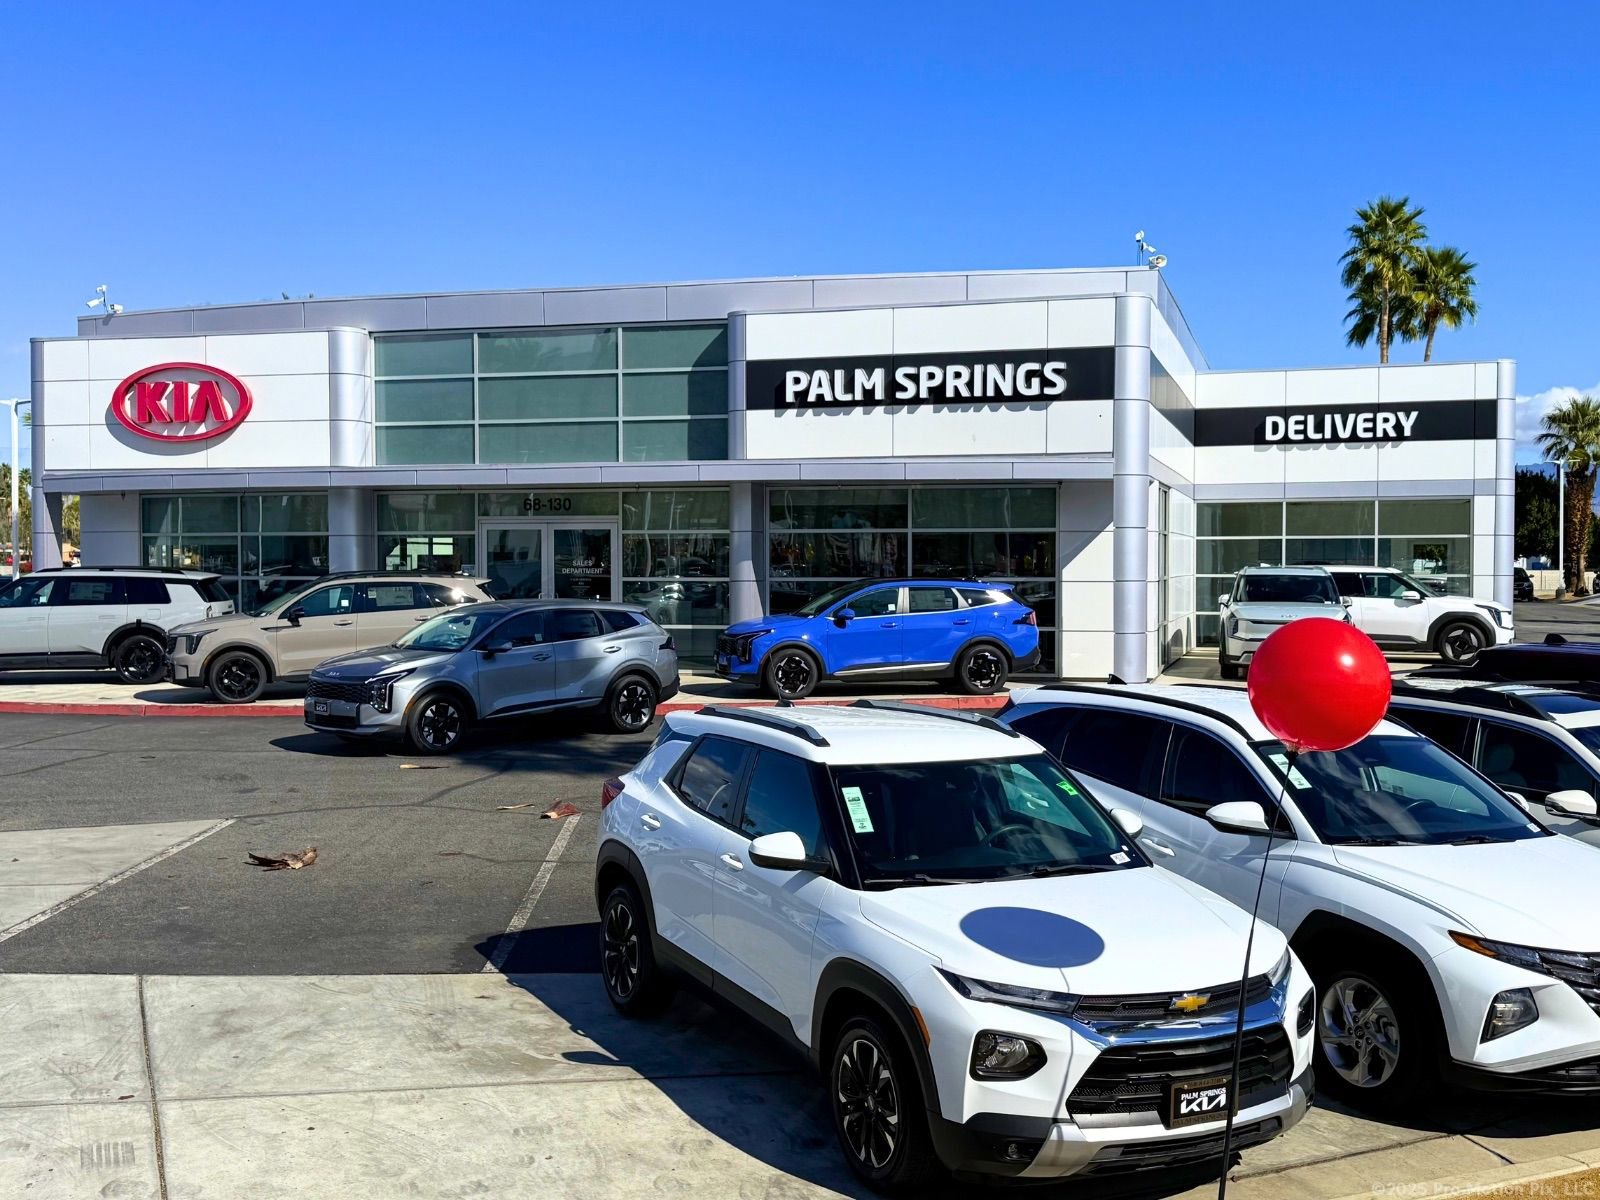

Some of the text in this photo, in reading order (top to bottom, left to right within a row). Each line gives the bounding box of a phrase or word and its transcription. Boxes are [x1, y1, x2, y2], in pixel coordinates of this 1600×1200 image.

[785, 361, 1067, 403] PALM SPRINGS
[135, 380, 229, 423] KIA
[1265, 411, 1419, 441] DELIVERY
[523, 498, 572, 511] 68-130
[1180, 1094, 1226, 1114] KIA
[1181, 1087, 1226, 1100] PALM SPRINGS
